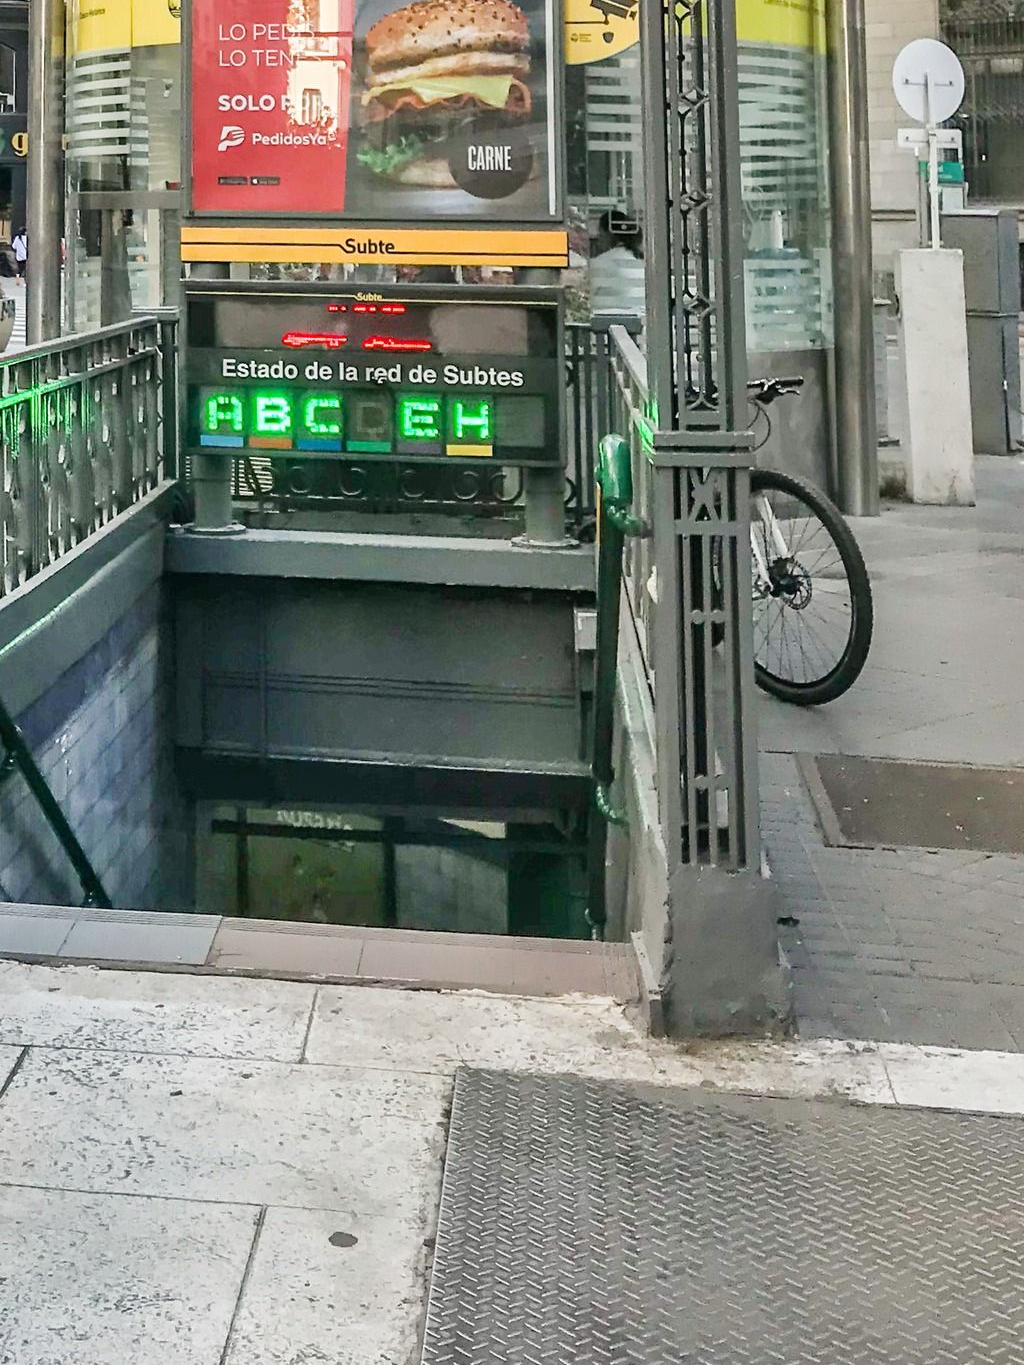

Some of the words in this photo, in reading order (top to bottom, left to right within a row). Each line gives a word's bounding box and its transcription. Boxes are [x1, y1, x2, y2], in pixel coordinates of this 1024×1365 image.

[219, 24, 246, 41] LO
[219, 50, 246, 67] LO
[218, 94, 276, 111] SOLO
[252, 133, 327, 146] PedidosYa
[468, 145, 512, 171] CARNE
[345, 238, 395, 254] Subte
[356, 292, 383, 302] Subte
[222, 358, 298, 380] Estado
[304, 362, 333, 380] de
[339, 363, 358, 381] la
[365, 364, 402, 383] red
[409, 365, 437, 383] de
[443, 365, 524, 386] Subtes
[207, 395, 243, 432] A
[255, 396, 292, 432] B
[304, 398, 341, 434] C
[401, 400, 439, 437] E
[454, 400, 490, 438] H
